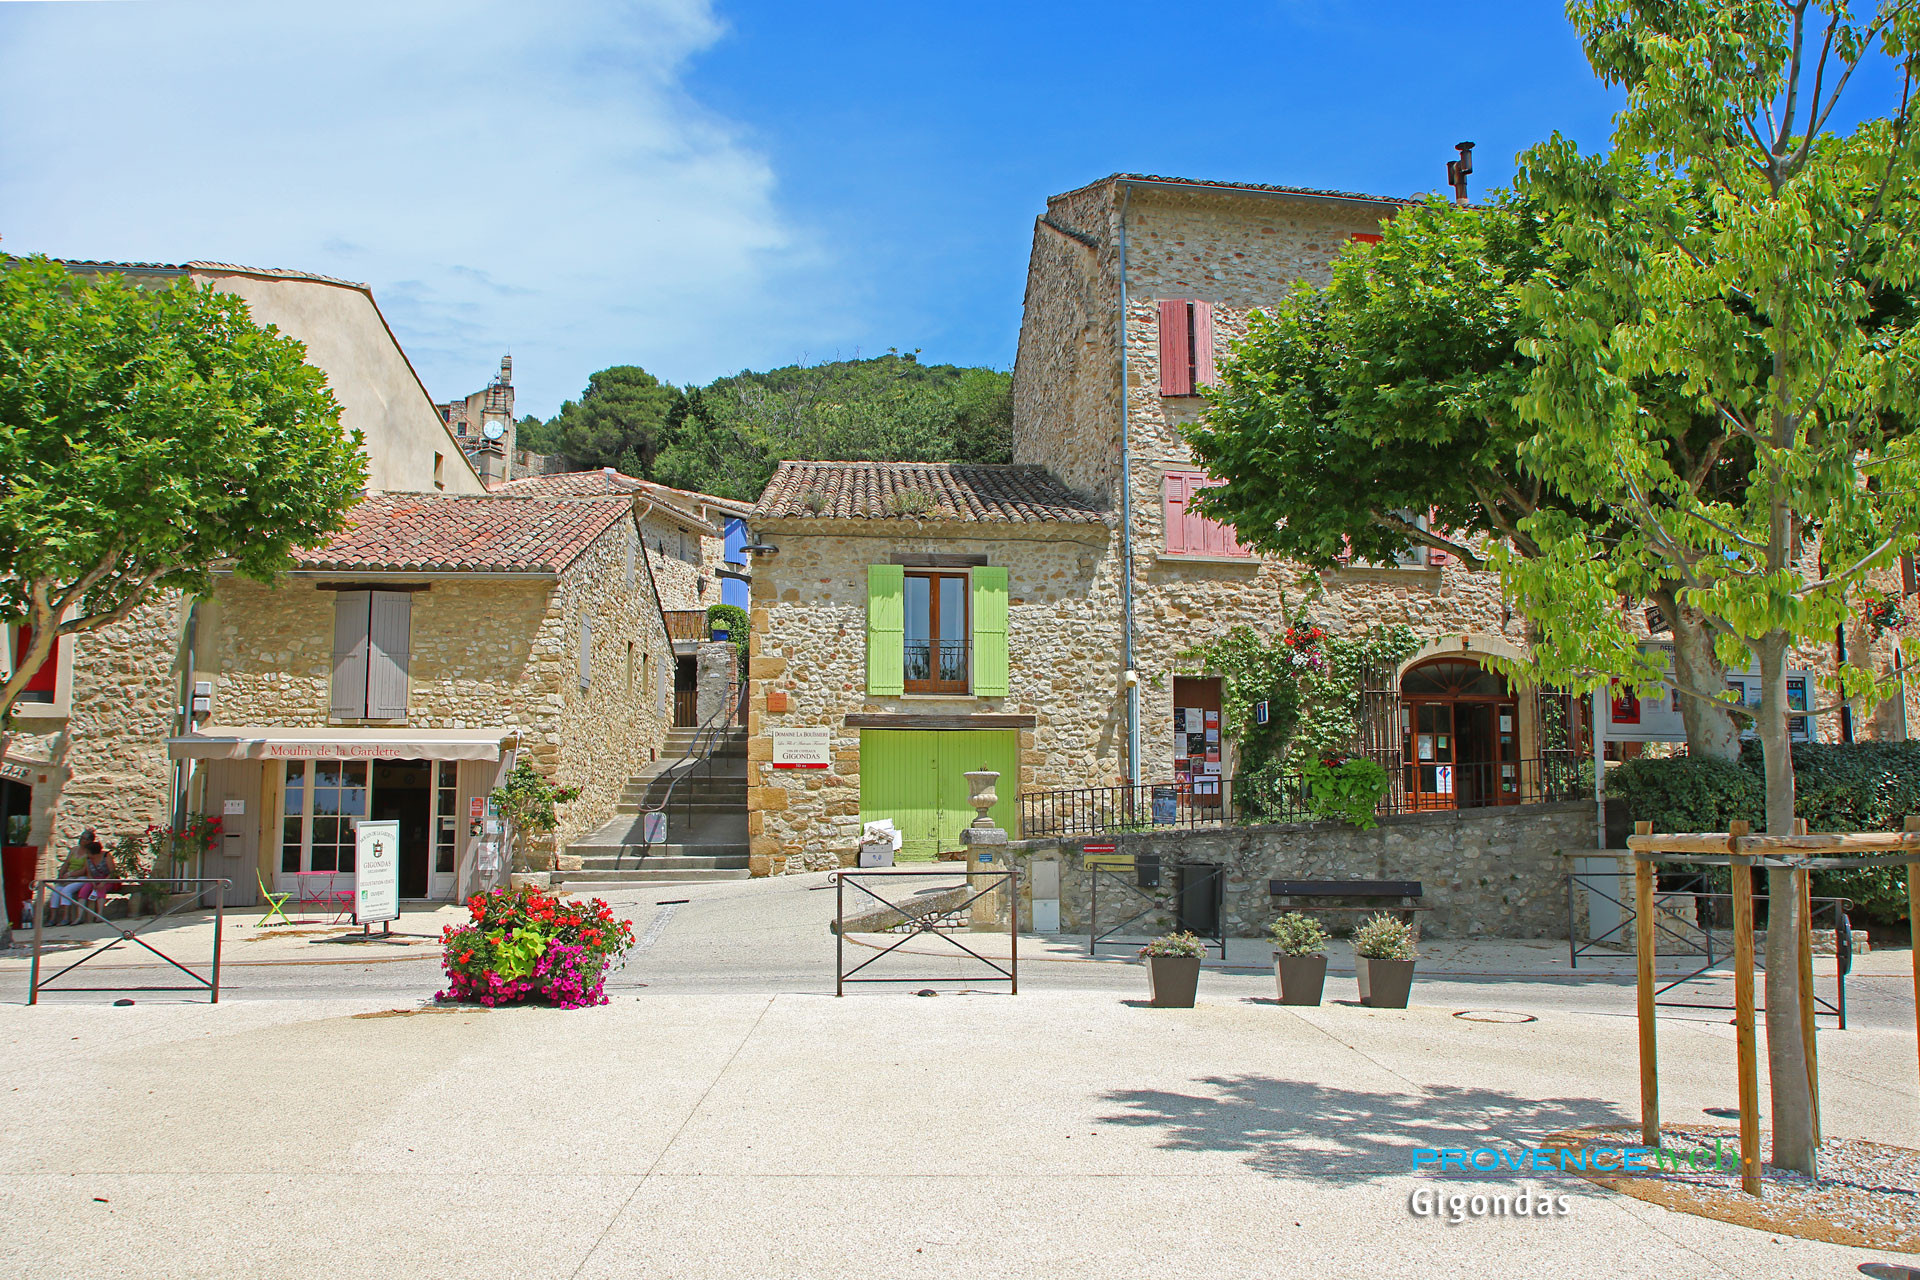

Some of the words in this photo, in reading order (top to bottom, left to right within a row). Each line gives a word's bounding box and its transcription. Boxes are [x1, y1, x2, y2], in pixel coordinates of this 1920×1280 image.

[271, 745, 312, 756] Moulin
[317, 745, 331, 756] de
[336, 745, 346, 756] la
[350, 745, 400, 757] Gardette
[363, 861, 391, 869] GIGONDAS
